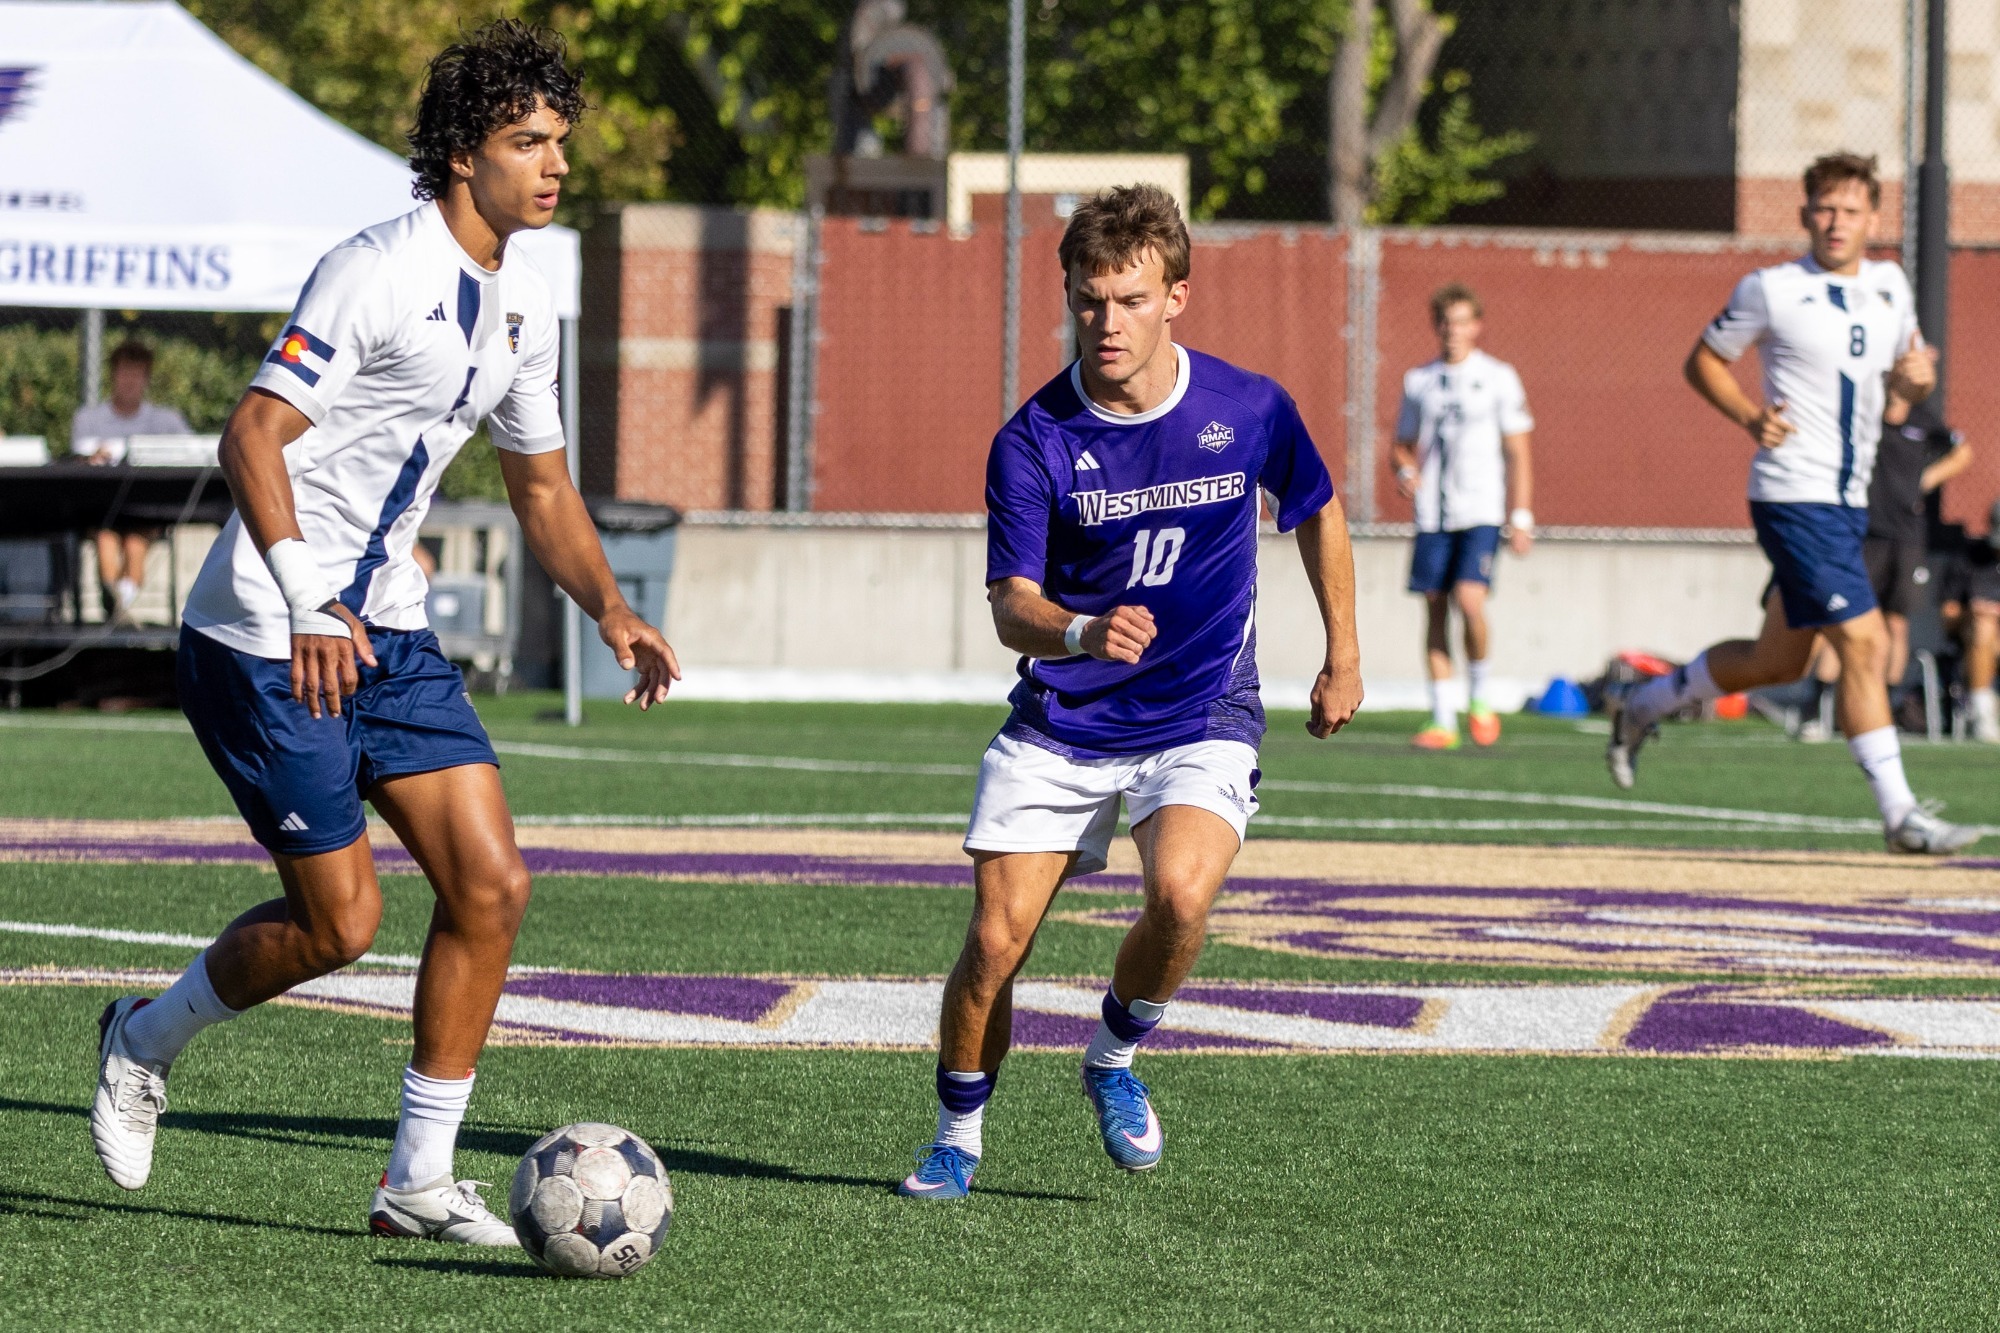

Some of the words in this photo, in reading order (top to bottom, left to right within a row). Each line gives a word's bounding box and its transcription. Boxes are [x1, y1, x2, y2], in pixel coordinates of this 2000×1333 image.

[1850, 325, 1866, 357] 8
[1200, 430, 1231, 445] RMAC
[1126, 527, 1186, 590] 10
